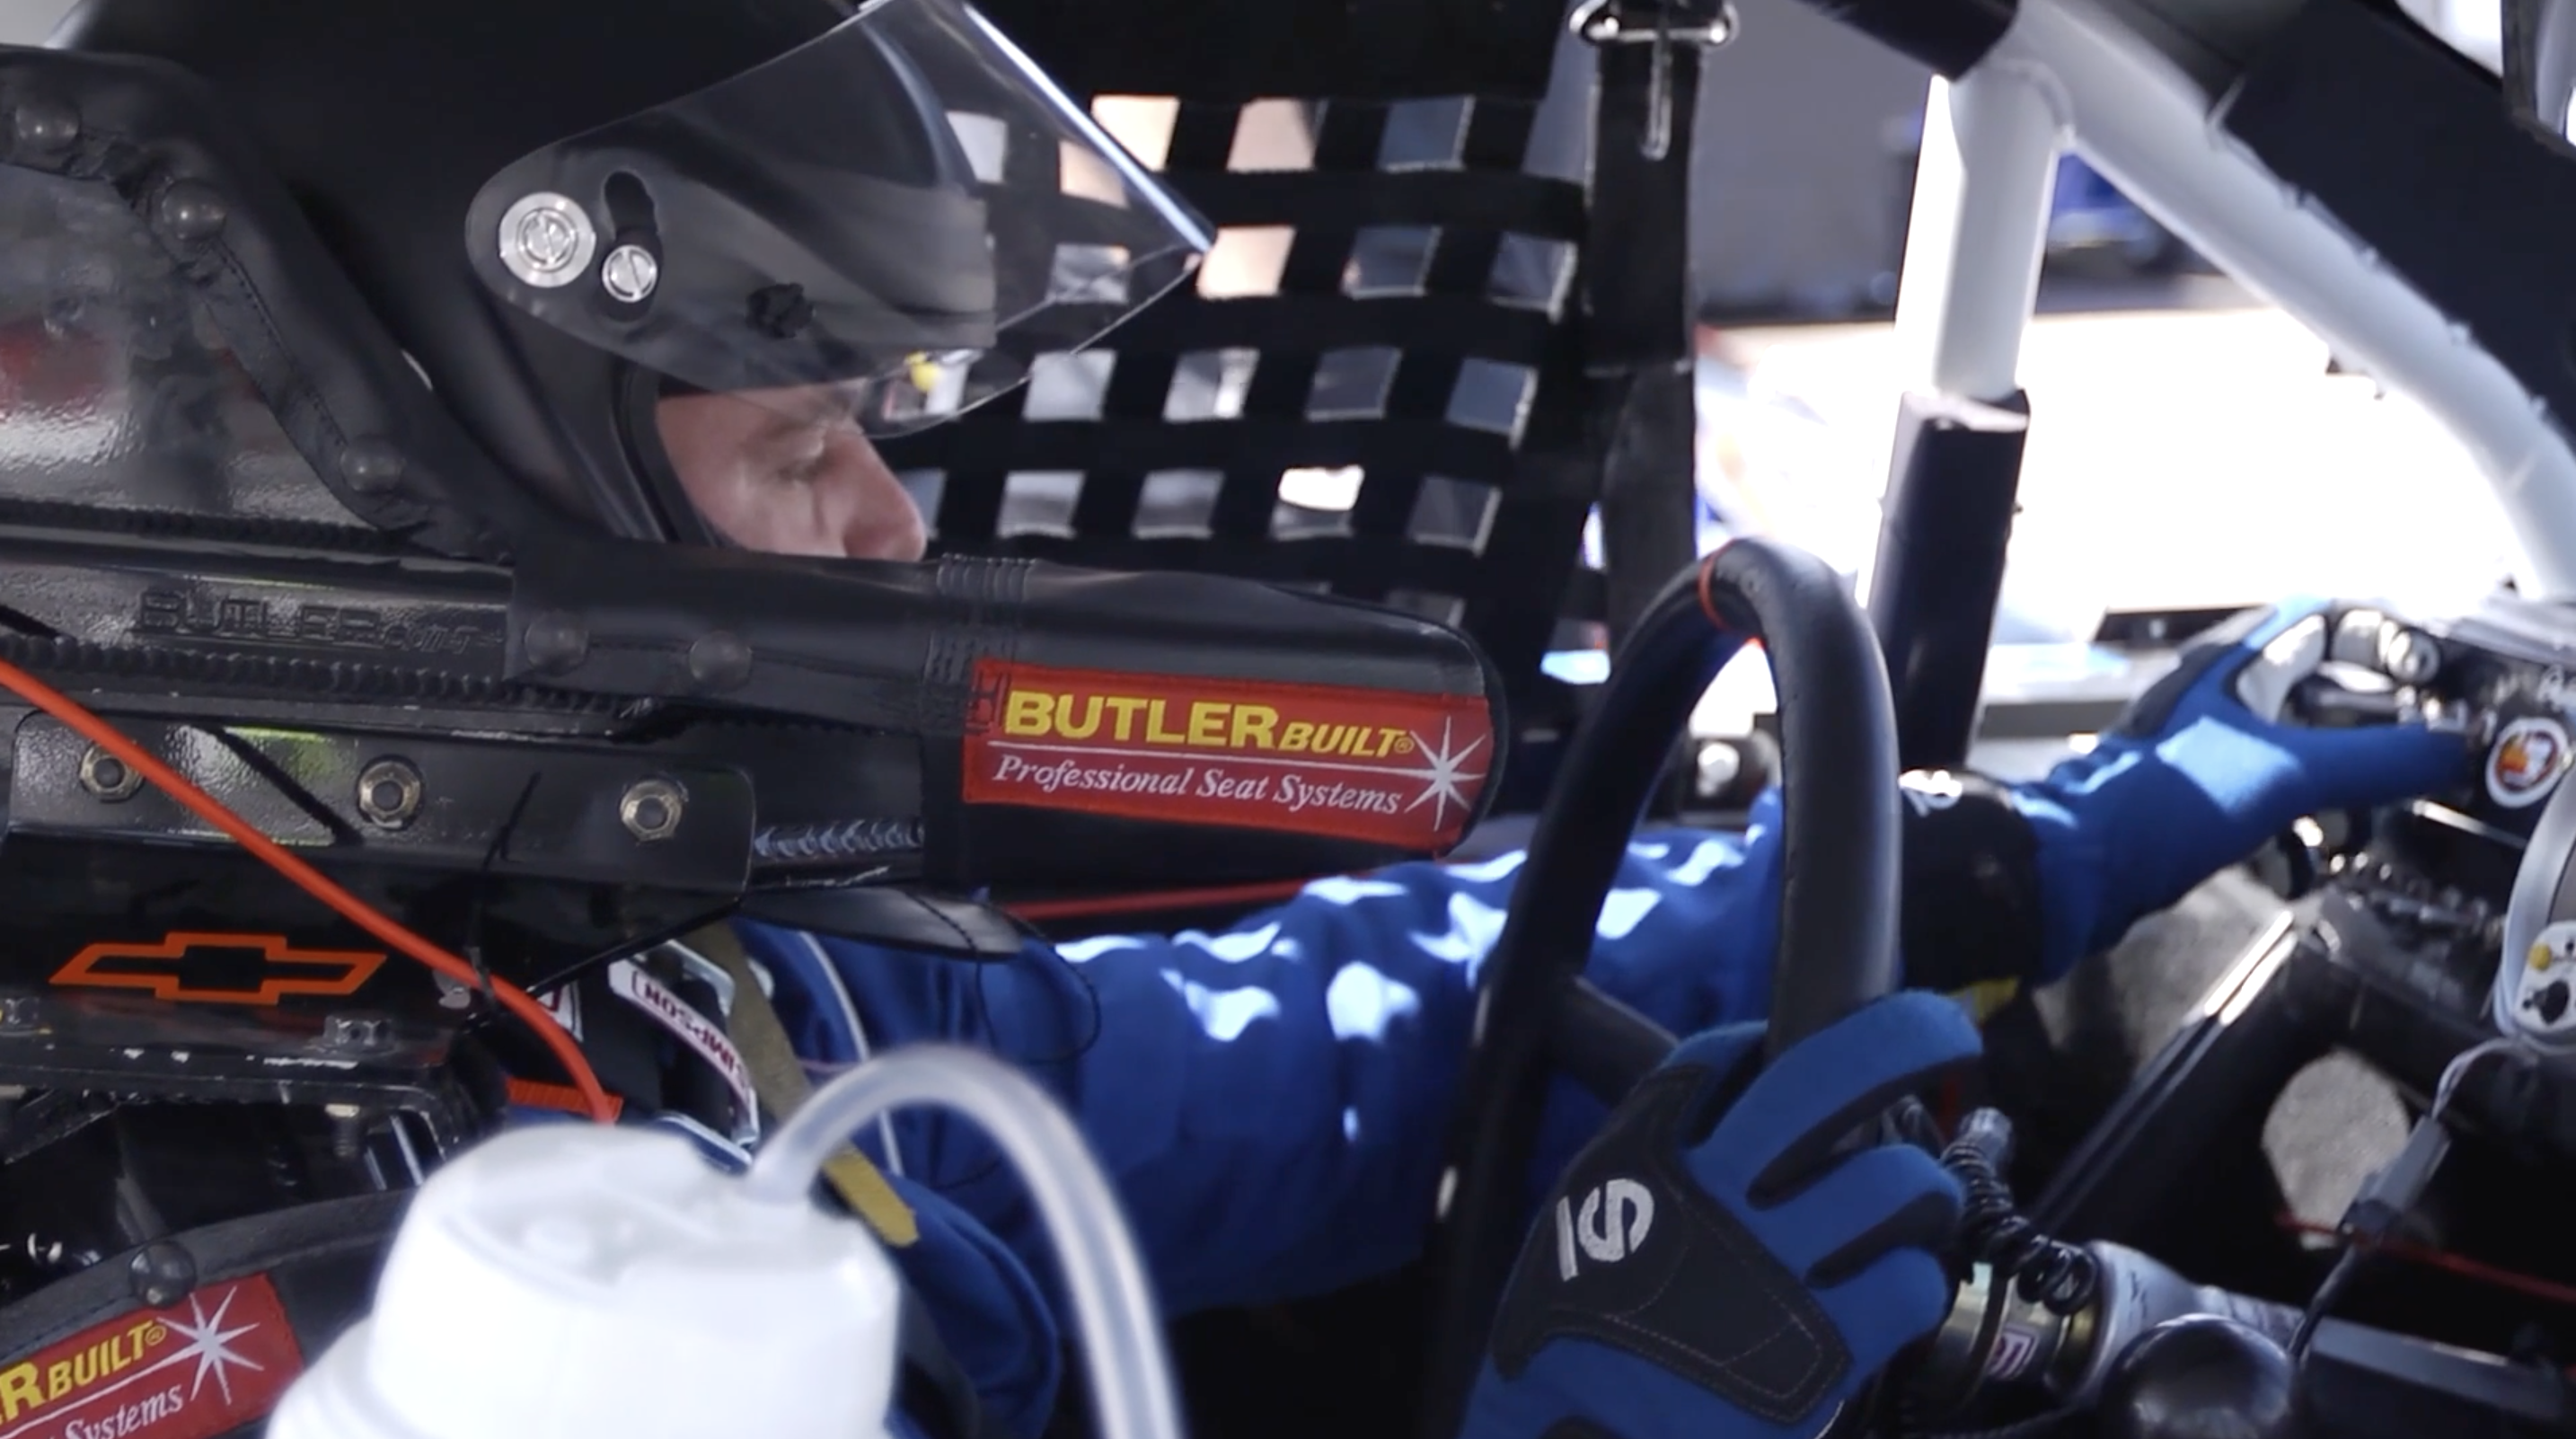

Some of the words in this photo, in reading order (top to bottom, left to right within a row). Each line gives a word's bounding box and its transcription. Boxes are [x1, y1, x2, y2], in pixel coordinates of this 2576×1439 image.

[1004, 689, 1278, 750] BUTLER
[992, 753, 1193, 795] Professional
[1195, 768, 1267, 799] Seat
[1271, 772, 1402, 815] Systems
